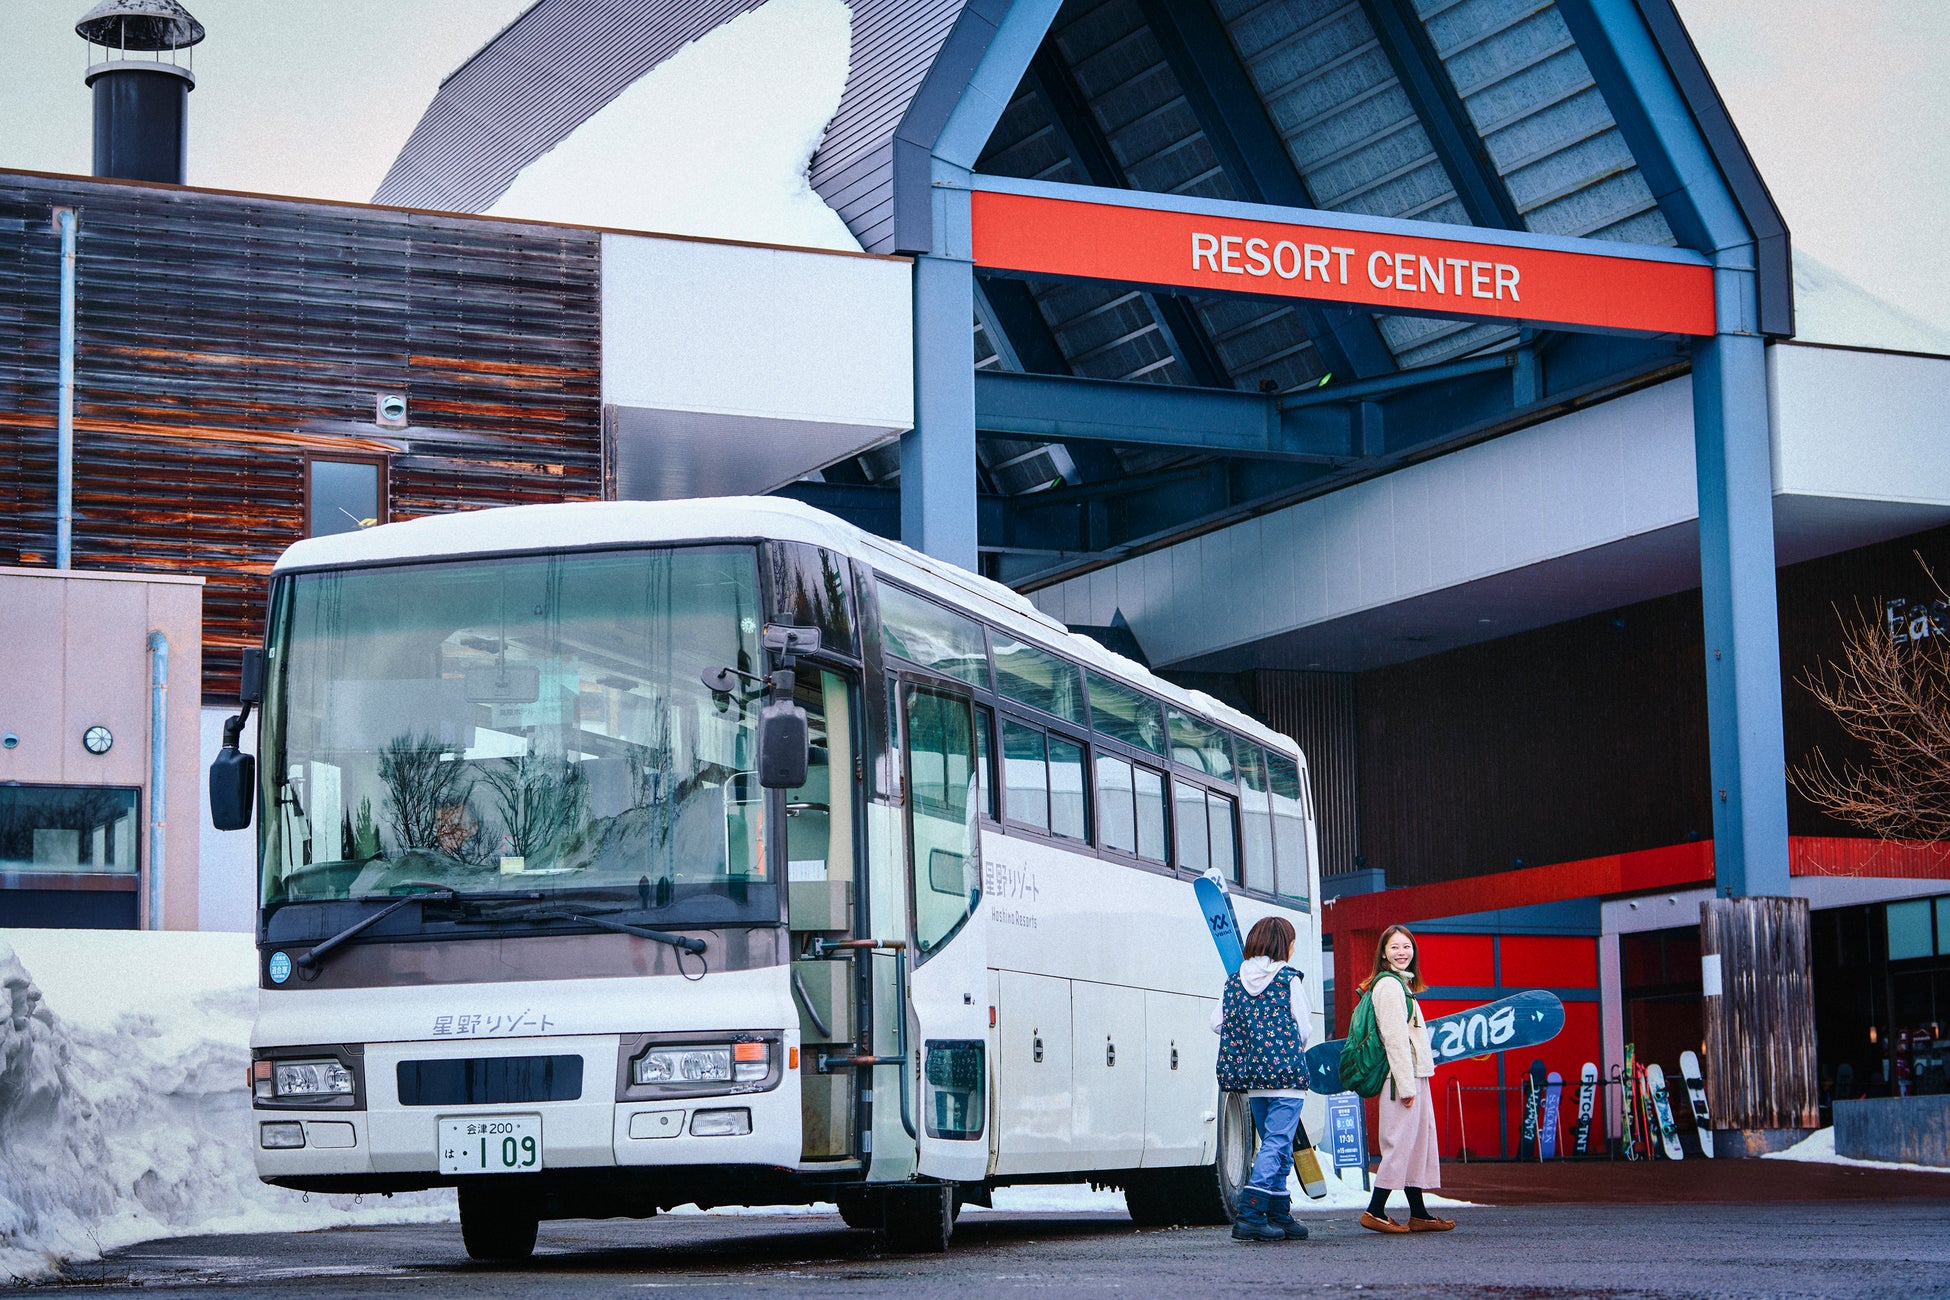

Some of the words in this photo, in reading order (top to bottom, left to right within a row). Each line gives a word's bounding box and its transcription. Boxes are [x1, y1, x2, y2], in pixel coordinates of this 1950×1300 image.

[1192, 232, 1354, 285] RESORT
[1368, 250, 1520, 302] CENTER
[985, 860, 1039, 902] 星野リゾート
[433, 1008, 554, 1036] 星野リゾート
[444, 1148, 455, 1159] は
